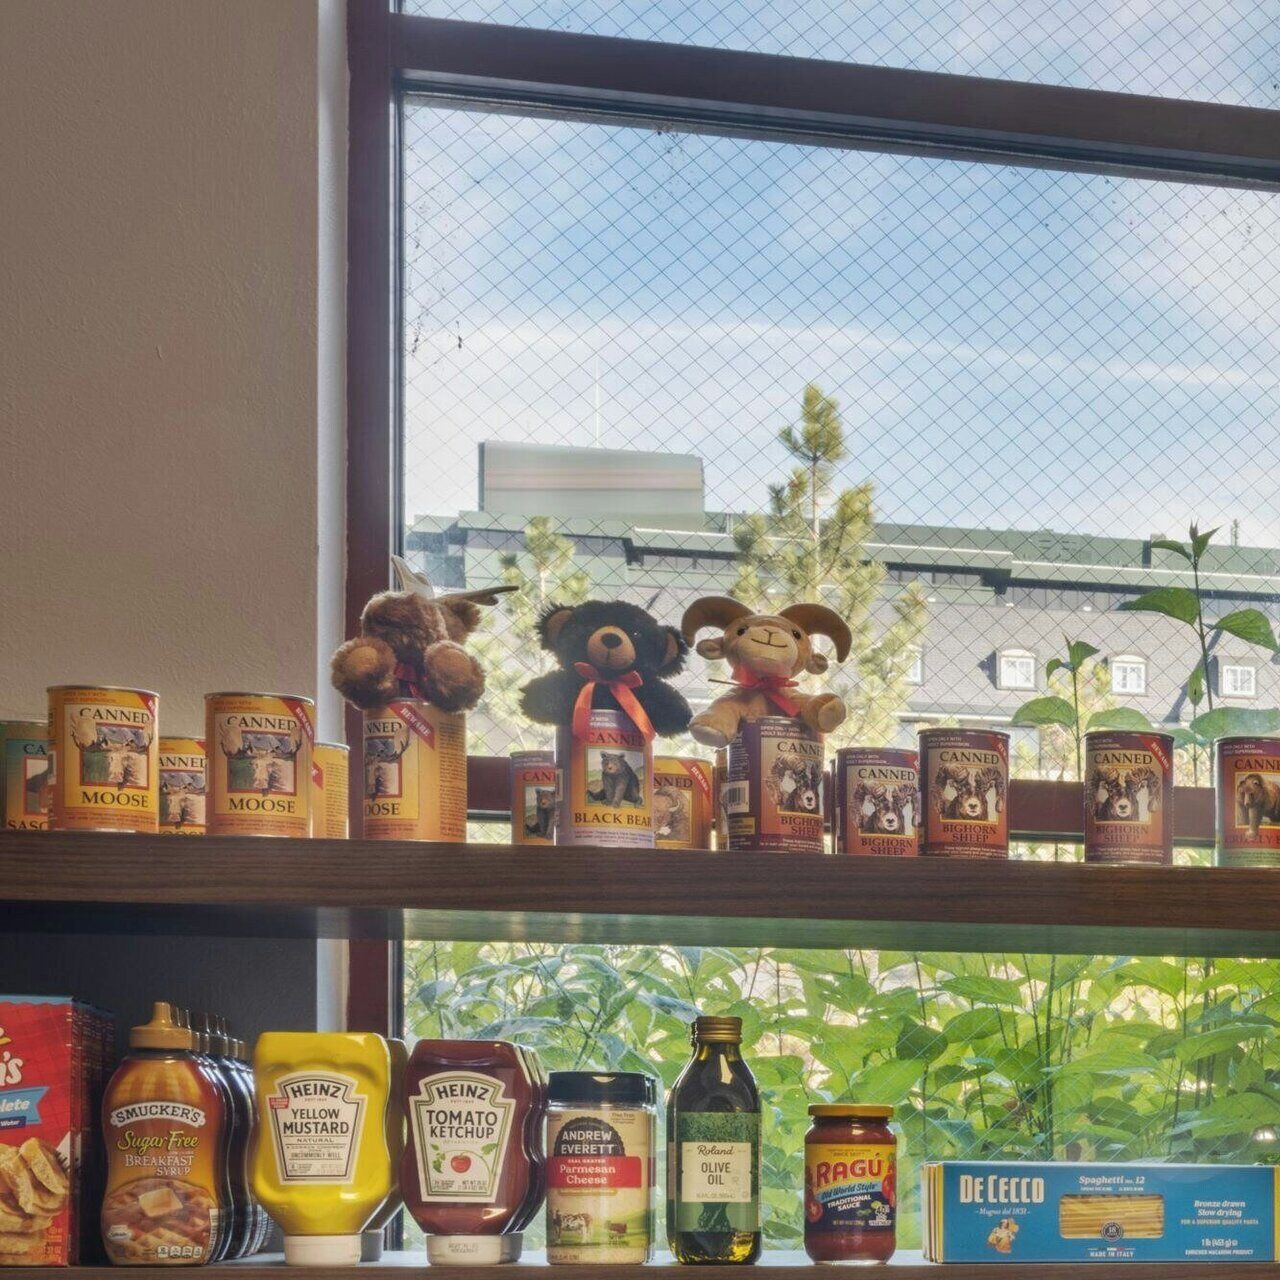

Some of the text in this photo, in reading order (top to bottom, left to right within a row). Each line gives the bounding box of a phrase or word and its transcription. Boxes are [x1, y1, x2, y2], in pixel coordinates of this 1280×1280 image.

[939, 750, 1000, 765] CANNED
[1094, 753, 1152, 766] CANNED
[80, 791, 149, 808] MOOSE
[228, 797, 295, 814] MOOSE
[574, 812, 623, 825] BLACK
[942, 823, 997, 836] BIGHORN
[861, 836, 913, 849] BIGHORN
[952, 832, 989, 844] SHEEP
[291, 1083, 342, 1099] HEINZ
[436, 1084, 490, 1100] HEINZ
[115, 1105, 201, 1124] SMUCKER'S
[291, 1109, 340, 1120] YELLOW
[426, 1110, 498, 1126] TOMATO
[283, 1121, 349, 1135] MUSTARD
[430, 1127, 494, 1139] KETCHUP
[562, 1130, 612, 1141] ANDREW
[117, 1131, 200, 1155] Sugar Free
[561, 1143, 615, 1155] EVERETT
[697, 1145, 735, 1157] Roland
[126, 1155, 194, 1167] BREAKFAST
[156, 1167, 192, 1177] SYRUP
[559, 1165, 616, 1176] Parmesan
[701, 1162, 731, 1175] OLIVE
[817, 1151, 882, 1188] RAGÚ
[566, 1175, 608, 1185] Cheese
[708, 1174, 724, 1185] OIL
[1079, 1175, 1145, 1186] Spaghetti 12
[960, 1175, 1044, 1203] DE CECCO
[828, 1194, 872, 1210] TRADITIONAL
[837, 1202, 861, 1212] SAUCE
